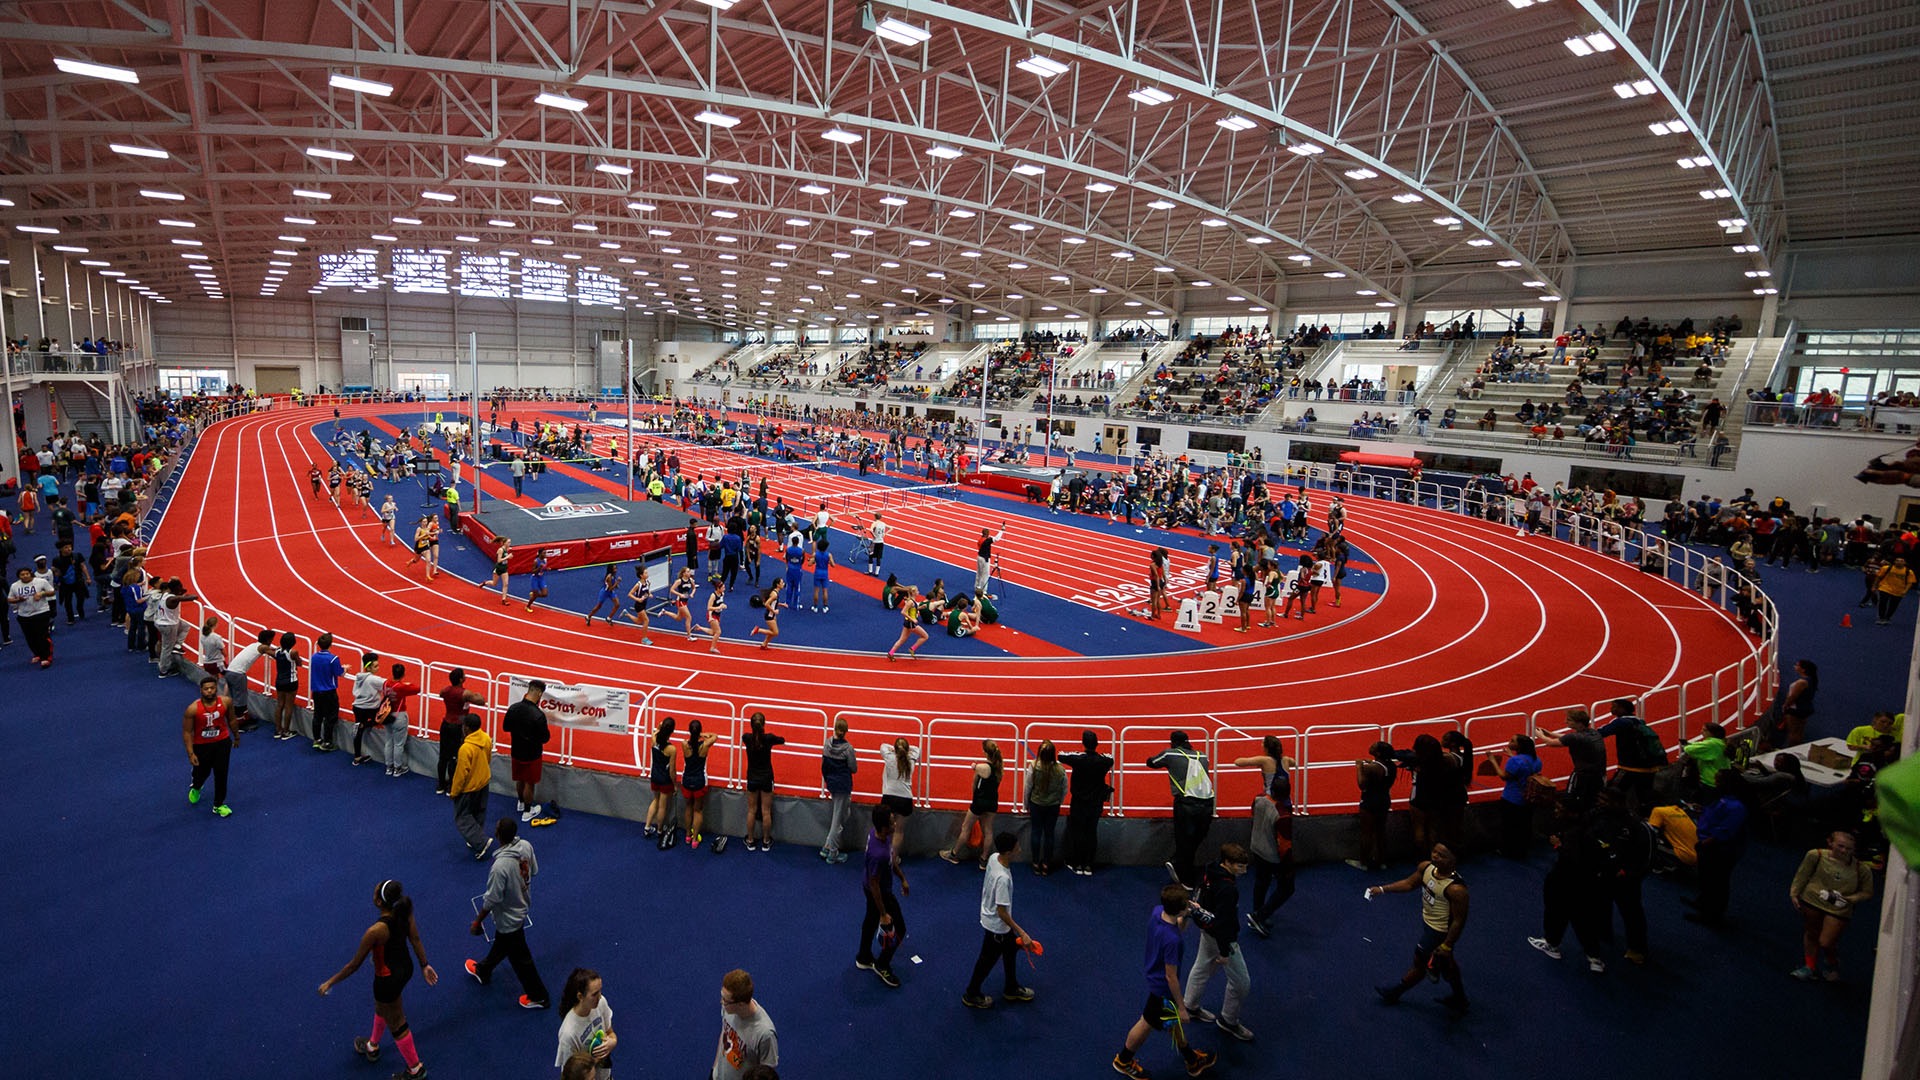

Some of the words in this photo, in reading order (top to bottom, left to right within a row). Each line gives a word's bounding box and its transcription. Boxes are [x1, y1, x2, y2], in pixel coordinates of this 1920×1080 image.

[610, 539, 632, 549] UCS
[17, 585, 37, 596] USA
[1290, 579, 1298, 591] 6
[1071, 594, 1111, 607] 1
[1095, 588, 1136, 602] 2
[1226, 595, 1236, 608] 3
[1252, 589, 1261, 602] 4
[1205, 601, 1216, 614] 2
[1185, 609, 1193, 623] 1
[539, 699, 607, 718] eStat.com
